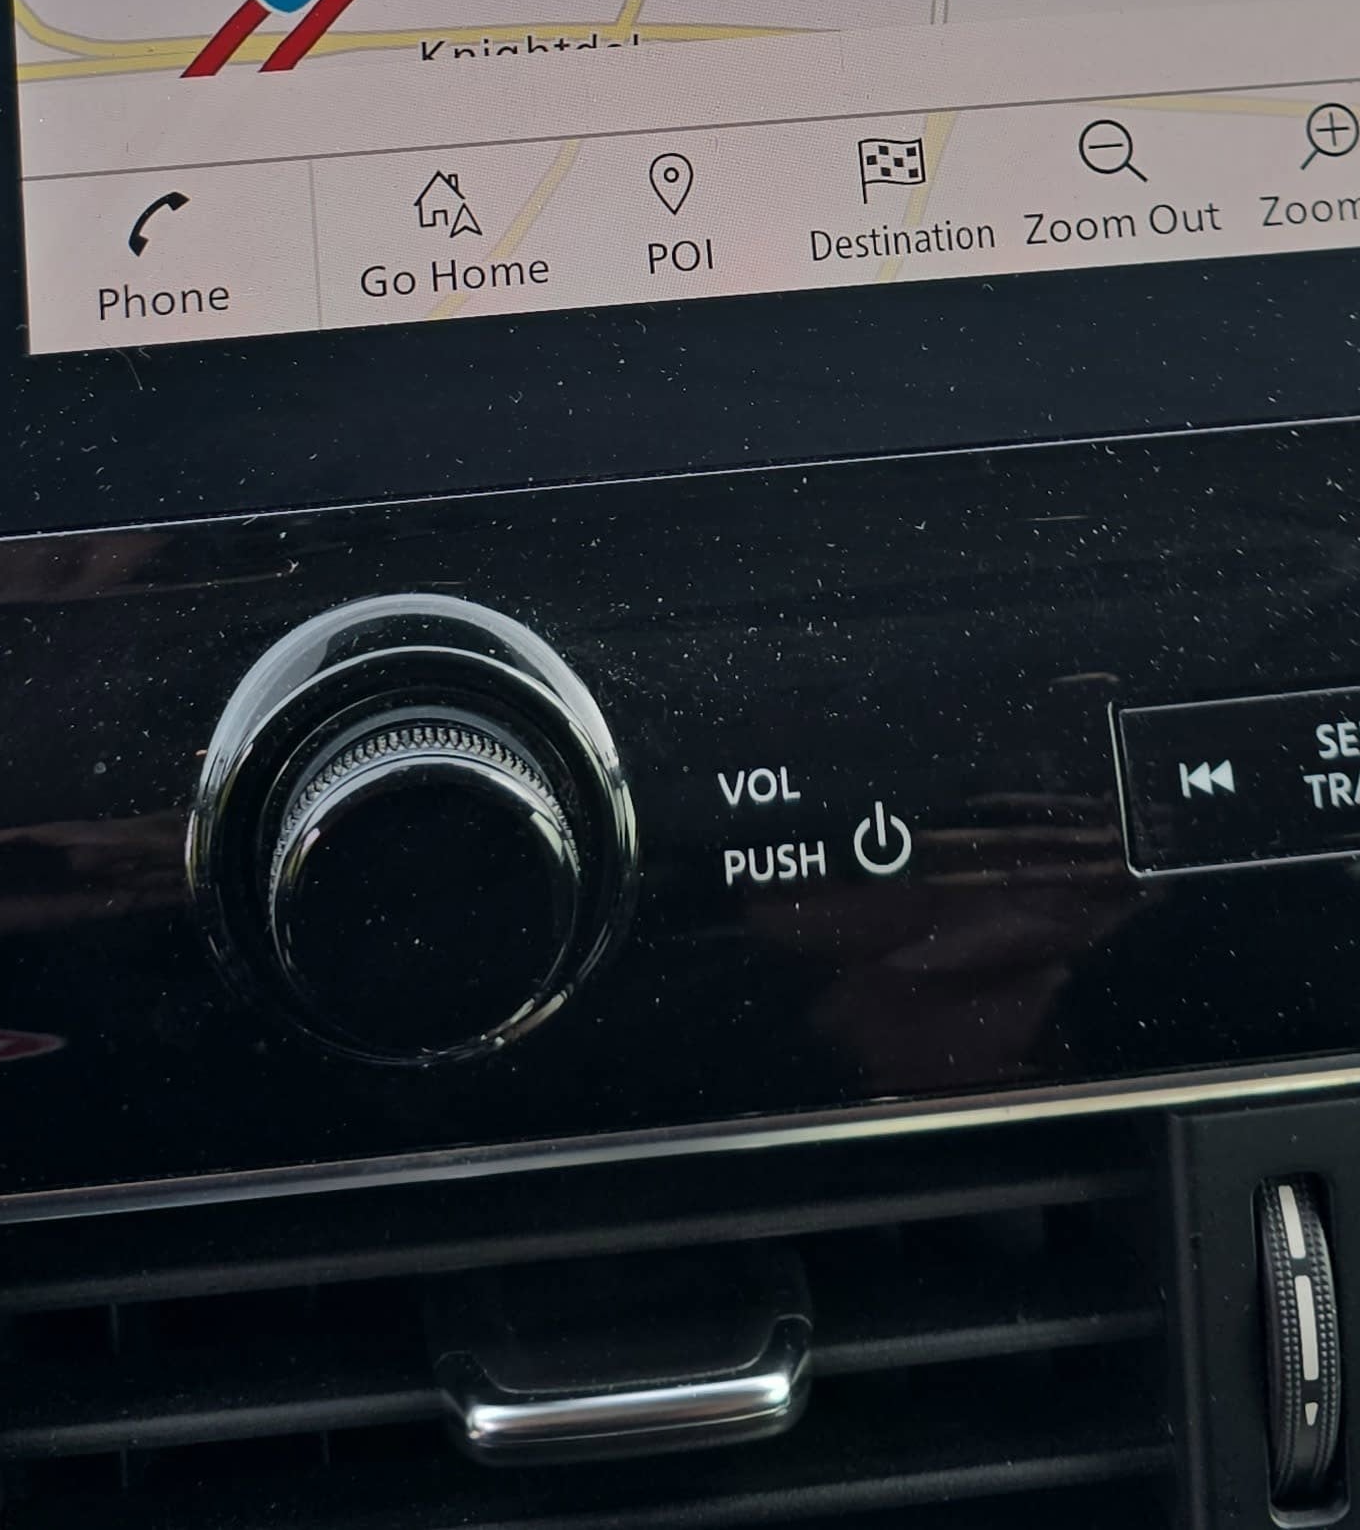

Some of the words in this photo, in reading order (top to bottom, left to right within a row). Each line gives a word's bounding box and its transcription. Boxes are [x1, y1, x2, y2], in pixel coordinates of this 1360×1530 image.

[809, 217, 996, 265] Destination
[1024, 208, 1136, 248] Zoom
[1148, 200, 1223, 237] Out
[359, 266, 417, 299] Go
[431, 257, 551, 295] Home
[646, 239, 715, 276] POI
[97, 281, 232, 322] Phone
[717, 766, 802, 807] VOL
[723, 840, 828, 887] PUSH
